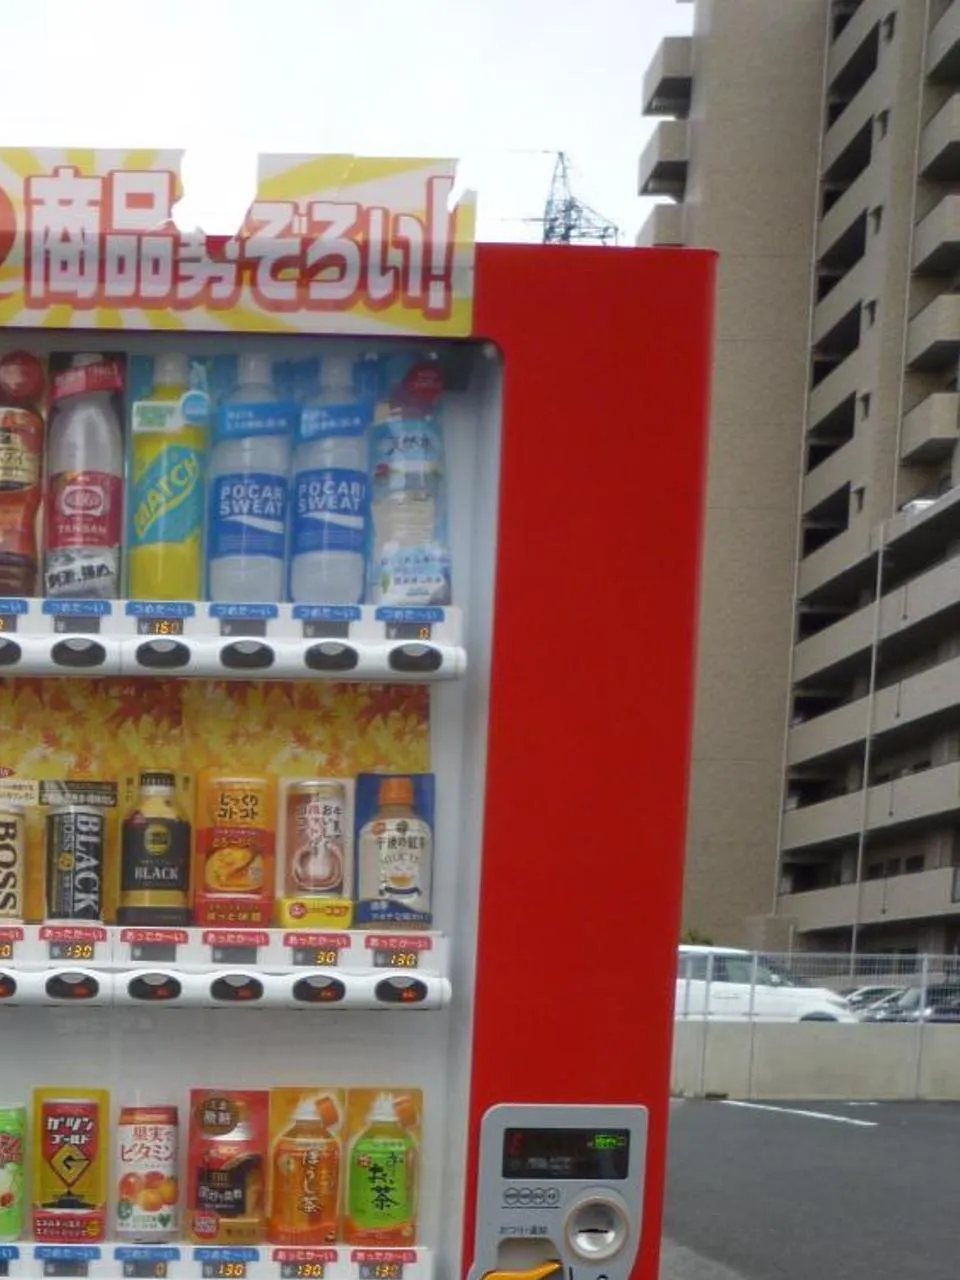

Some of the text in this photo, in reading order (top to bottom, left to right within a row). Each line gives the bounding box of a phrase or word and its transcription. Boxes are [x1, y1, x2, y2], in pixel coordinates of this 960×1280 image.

[299, 482, 365, 499] POCARI
[220, 500, 282, 516] SWEAT
[298, 497, 361, 514] SWEAT
[219, 792, 258, 807] じっくり
[217, 807, 259, 821] コトコト
[75, 814, 100, 912] BLACK
[134, 866, 179, 881] BLACK
[120, 1144, 176, 1163] ビタミン
[368, 1163, 398, 1211] お茶
